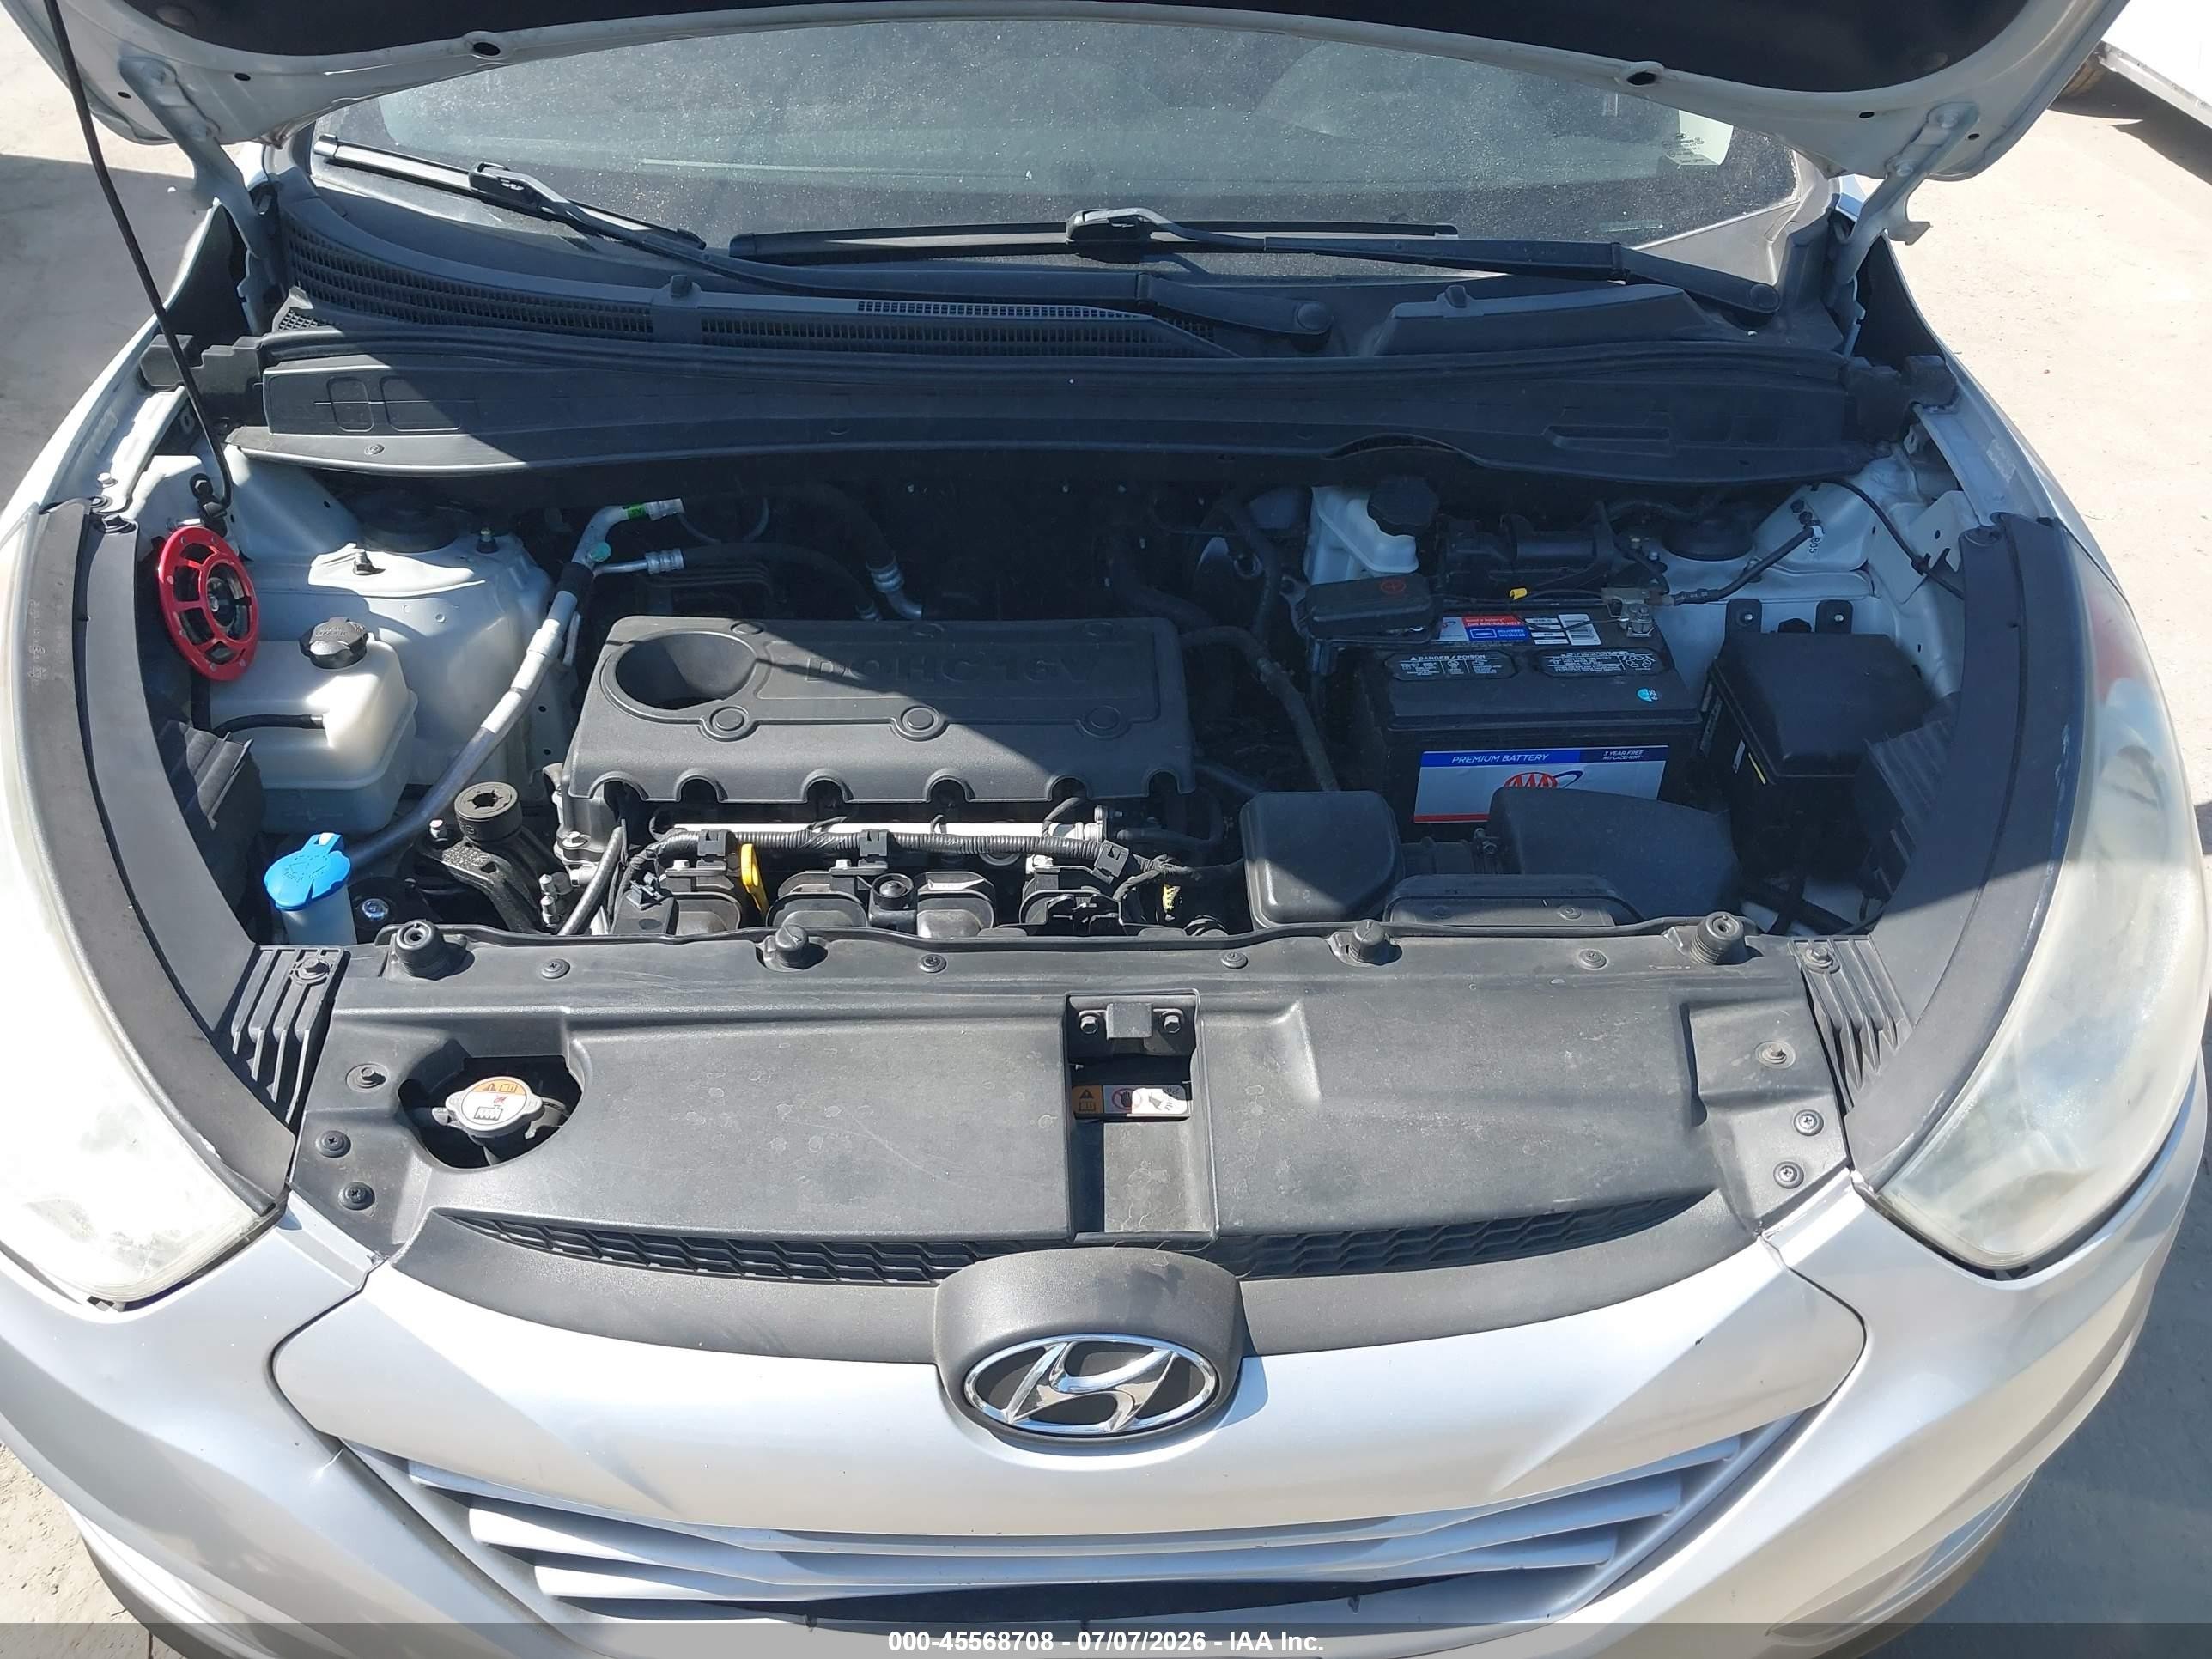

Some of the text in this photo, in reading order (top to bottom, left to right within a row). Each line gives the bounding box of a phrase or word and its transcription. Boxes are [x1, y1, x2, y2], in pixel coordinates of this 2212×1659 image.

[805, 655, 985, 684] DOHC
[1451, 753, 1550, 763] PREMIUM BATTERY
